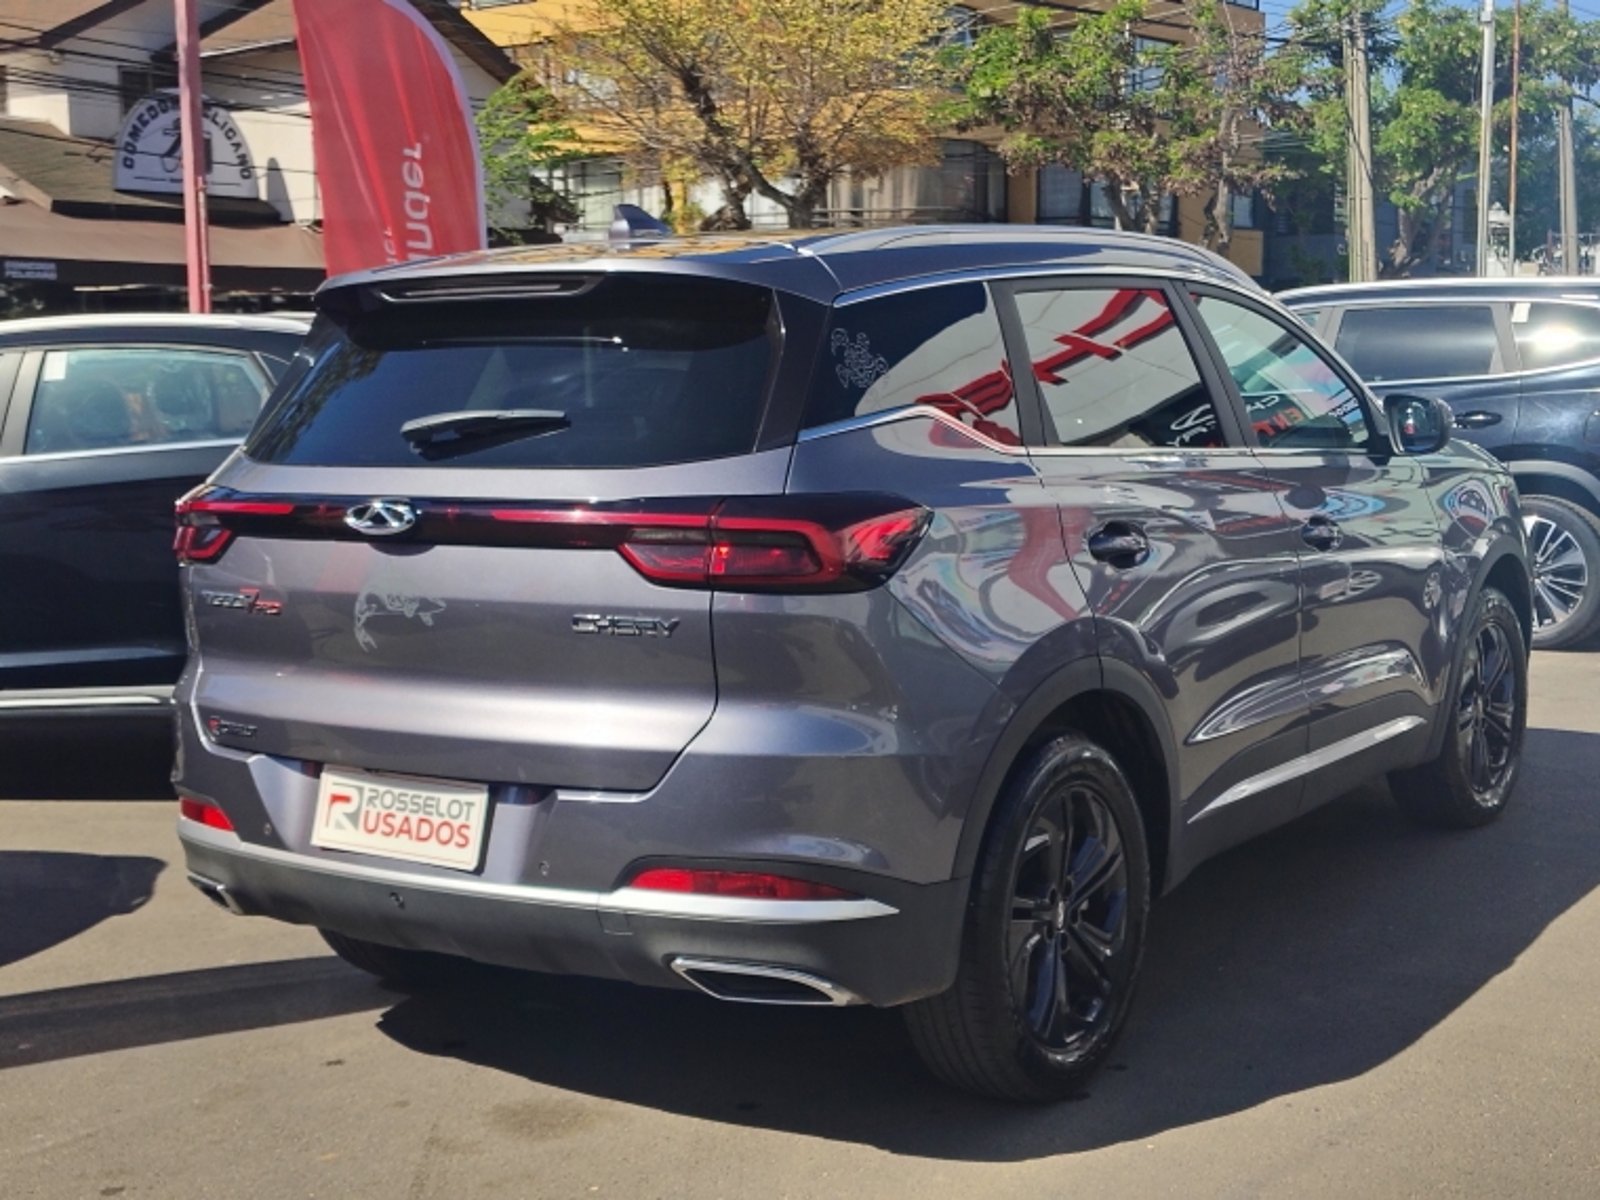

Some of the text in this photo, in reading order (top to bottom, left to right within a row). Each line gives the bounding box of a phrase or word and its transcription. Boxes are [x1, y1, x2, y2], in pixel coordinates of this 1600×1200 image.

[201, 104, 252, 180] ELICANO
[572, 613, 679, 637] CHERY
[366, 788, 475, 822] ROSSELOT
[363, 810, 471, 848] USADOS
